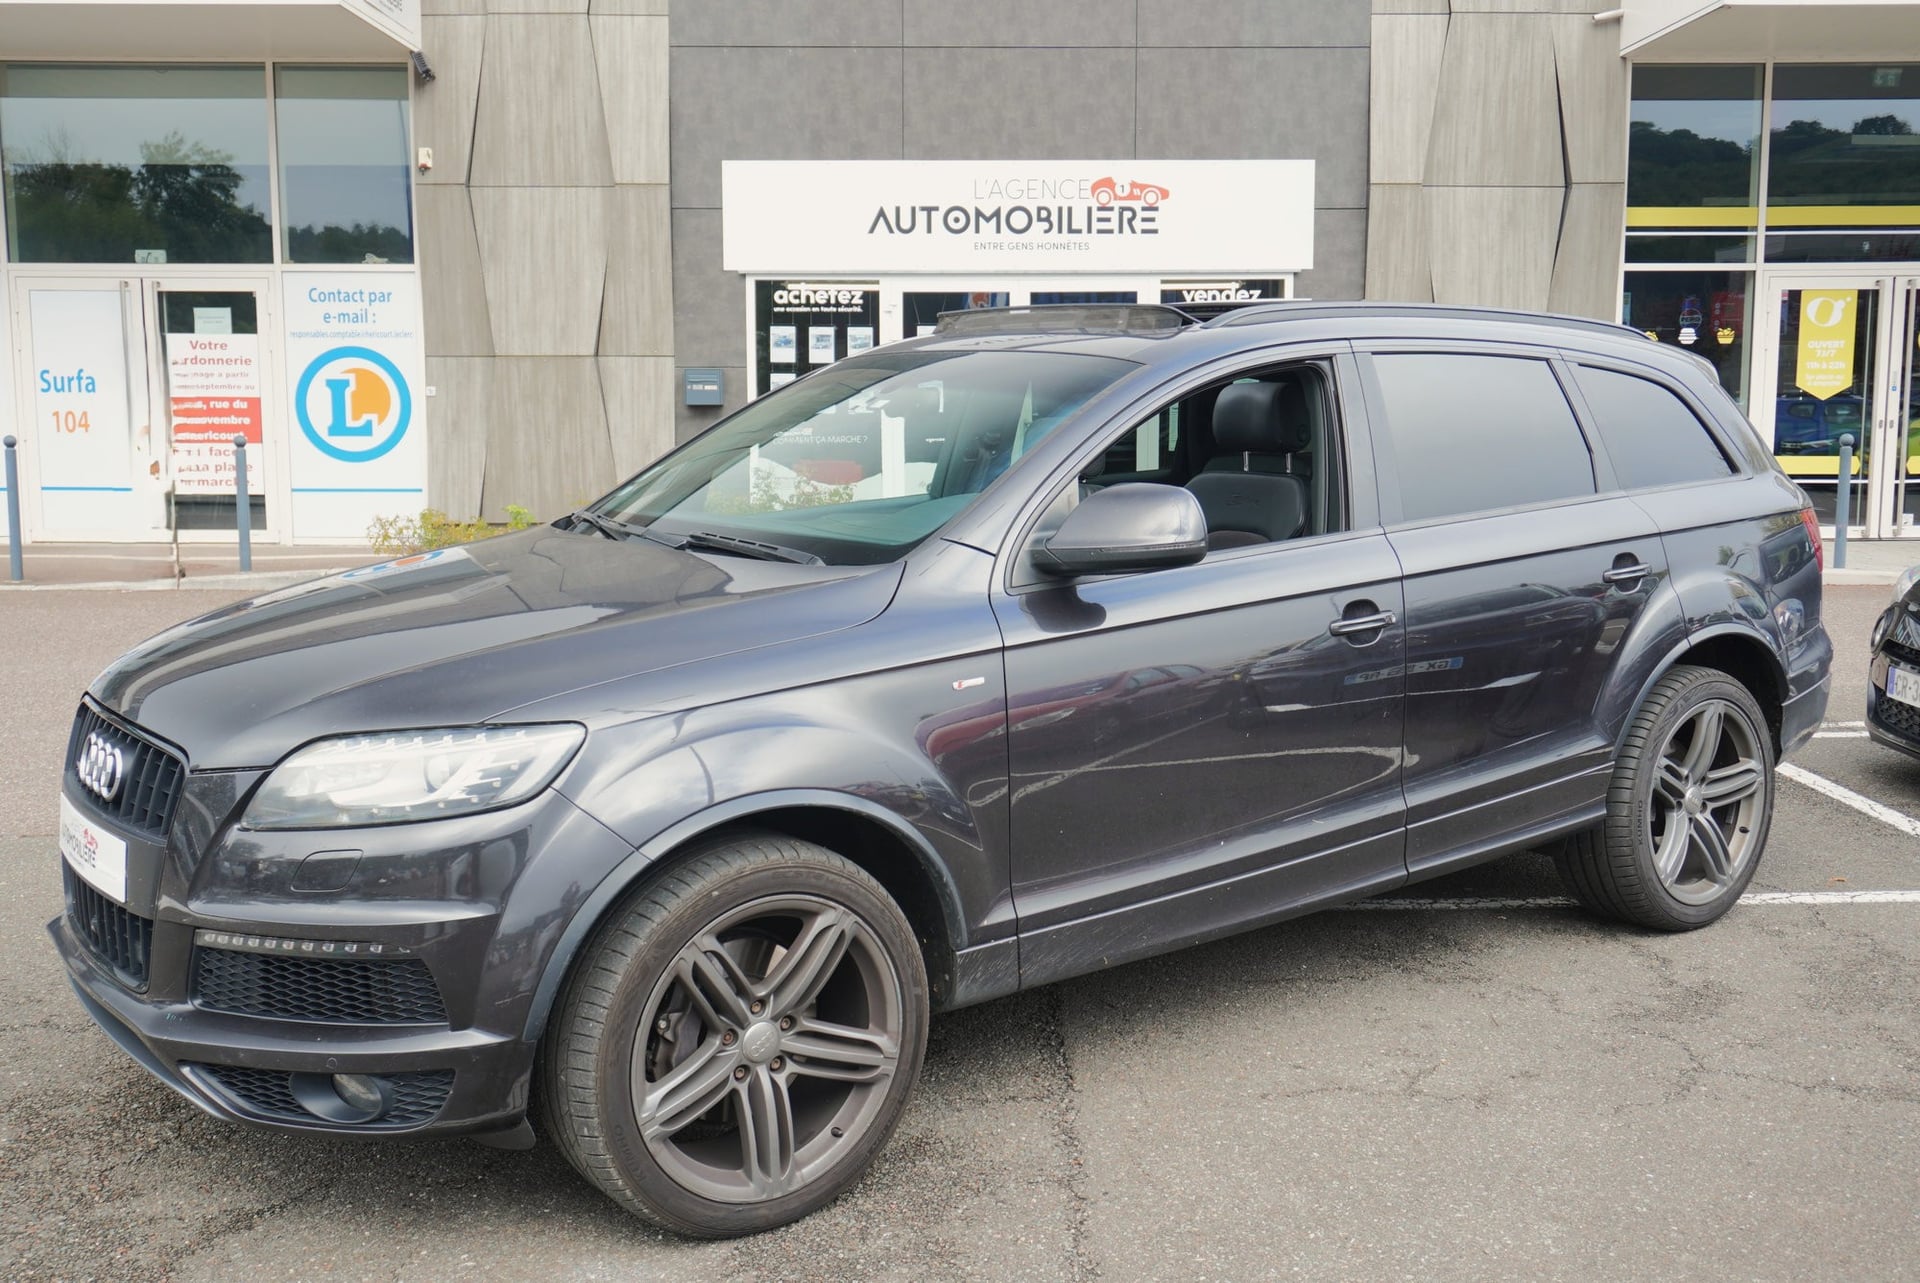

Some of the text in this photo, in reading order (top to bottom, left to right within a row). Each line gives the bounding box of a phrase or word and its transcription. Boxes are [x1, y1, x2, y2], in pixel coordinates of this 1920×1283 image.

[973, 179, 1090, 200] L'AGENCE
[974, 242, 1004, 250] ENTRE
[1008, 242, 1034, 250] GENS
[308, 287, 392, 306] Contact par
[773, 283, 864, 304] achetez
[1182, 282, 1262, 302] vendez
[323, 308, 368, 323] e-mail
[189, 340, 228, 351] Votre
[174, 355, 252, 366] rdonnerie
[39, 369, 97, 394] Surfa
[209, 401, 230, 409] rue
[233, 400, 248, 409] du
[52, 410, 90, 433] 104
[194, 415, 251, 424] vembre
[215, 462, 253, 473] plae
[197, 478, 255, 486] marc.
